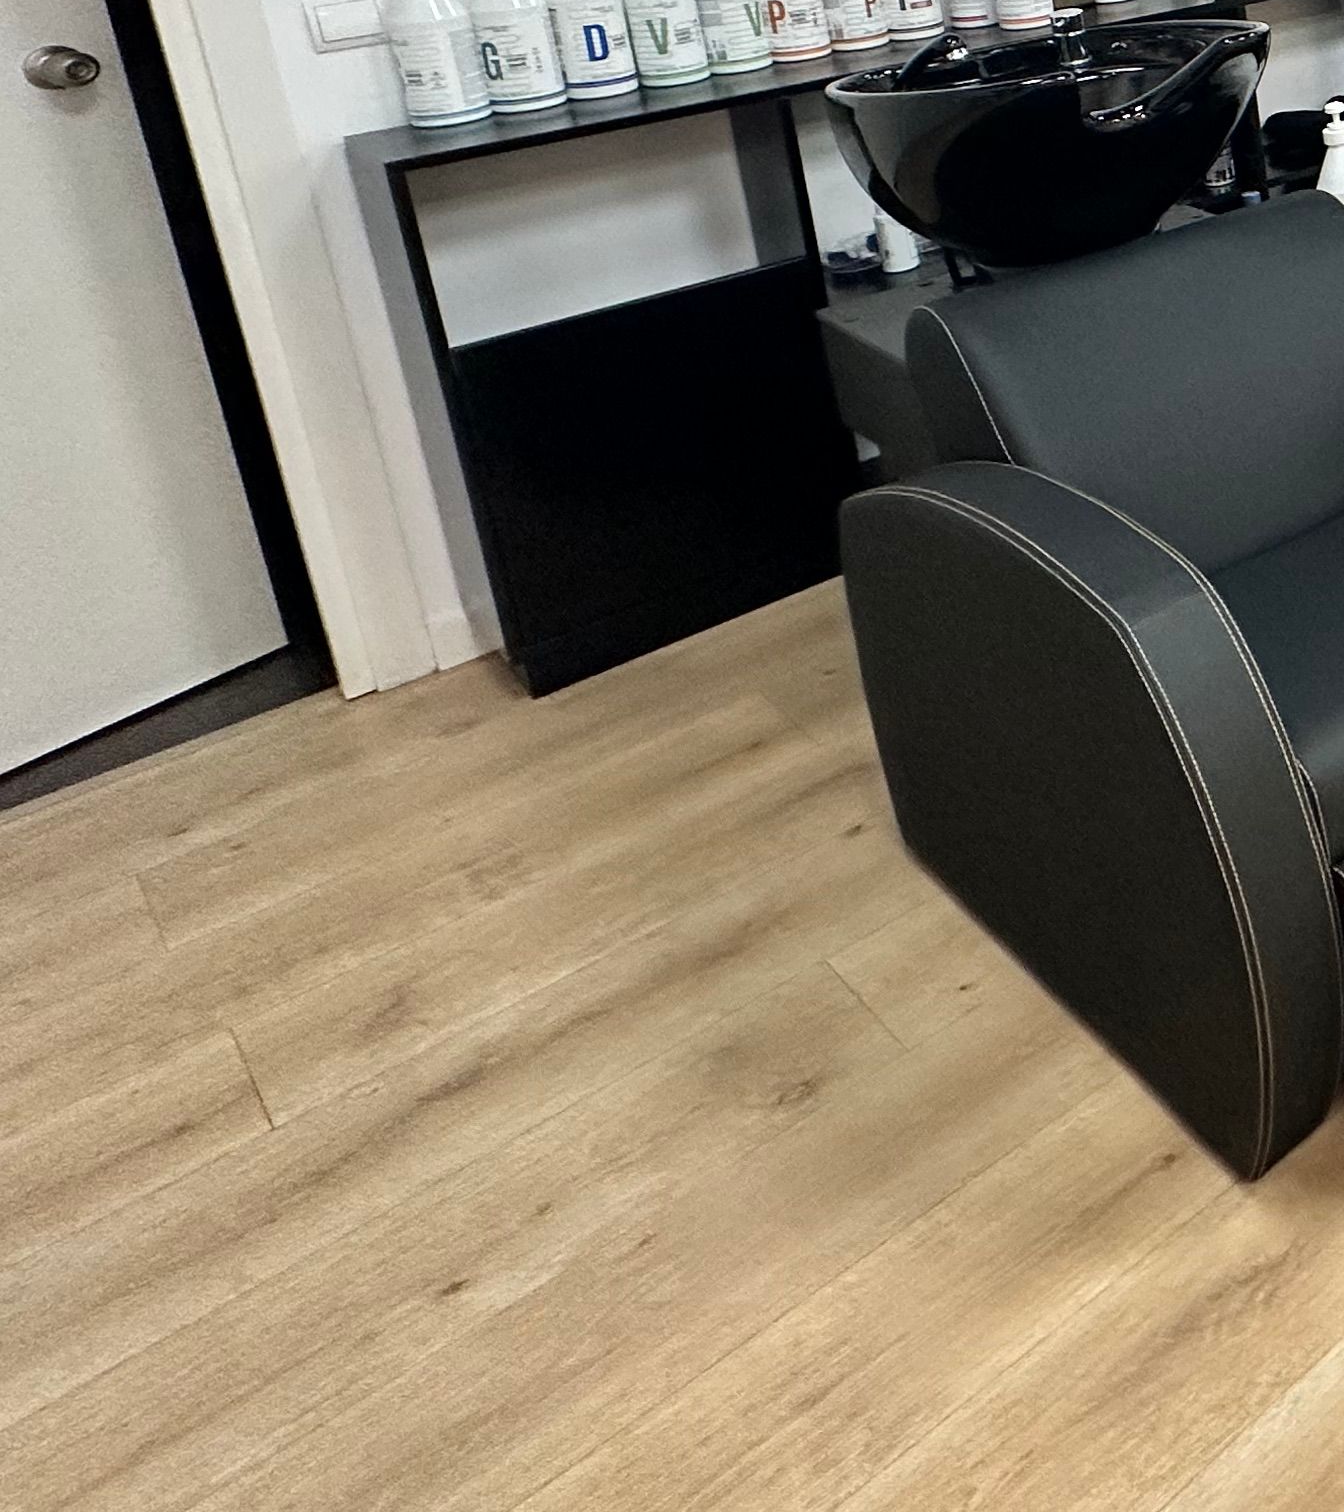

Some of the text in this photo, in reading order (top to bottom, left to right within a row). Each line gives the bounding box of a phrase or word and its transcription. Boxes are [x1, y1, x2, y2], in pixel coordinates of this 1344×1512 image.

[743, 1, 762, 37] V
[767, 0, 786, 34] P
[583, 23, 609, 63] D
[646, 18, 669, 55] V
[481, 41, 504, 81] G
